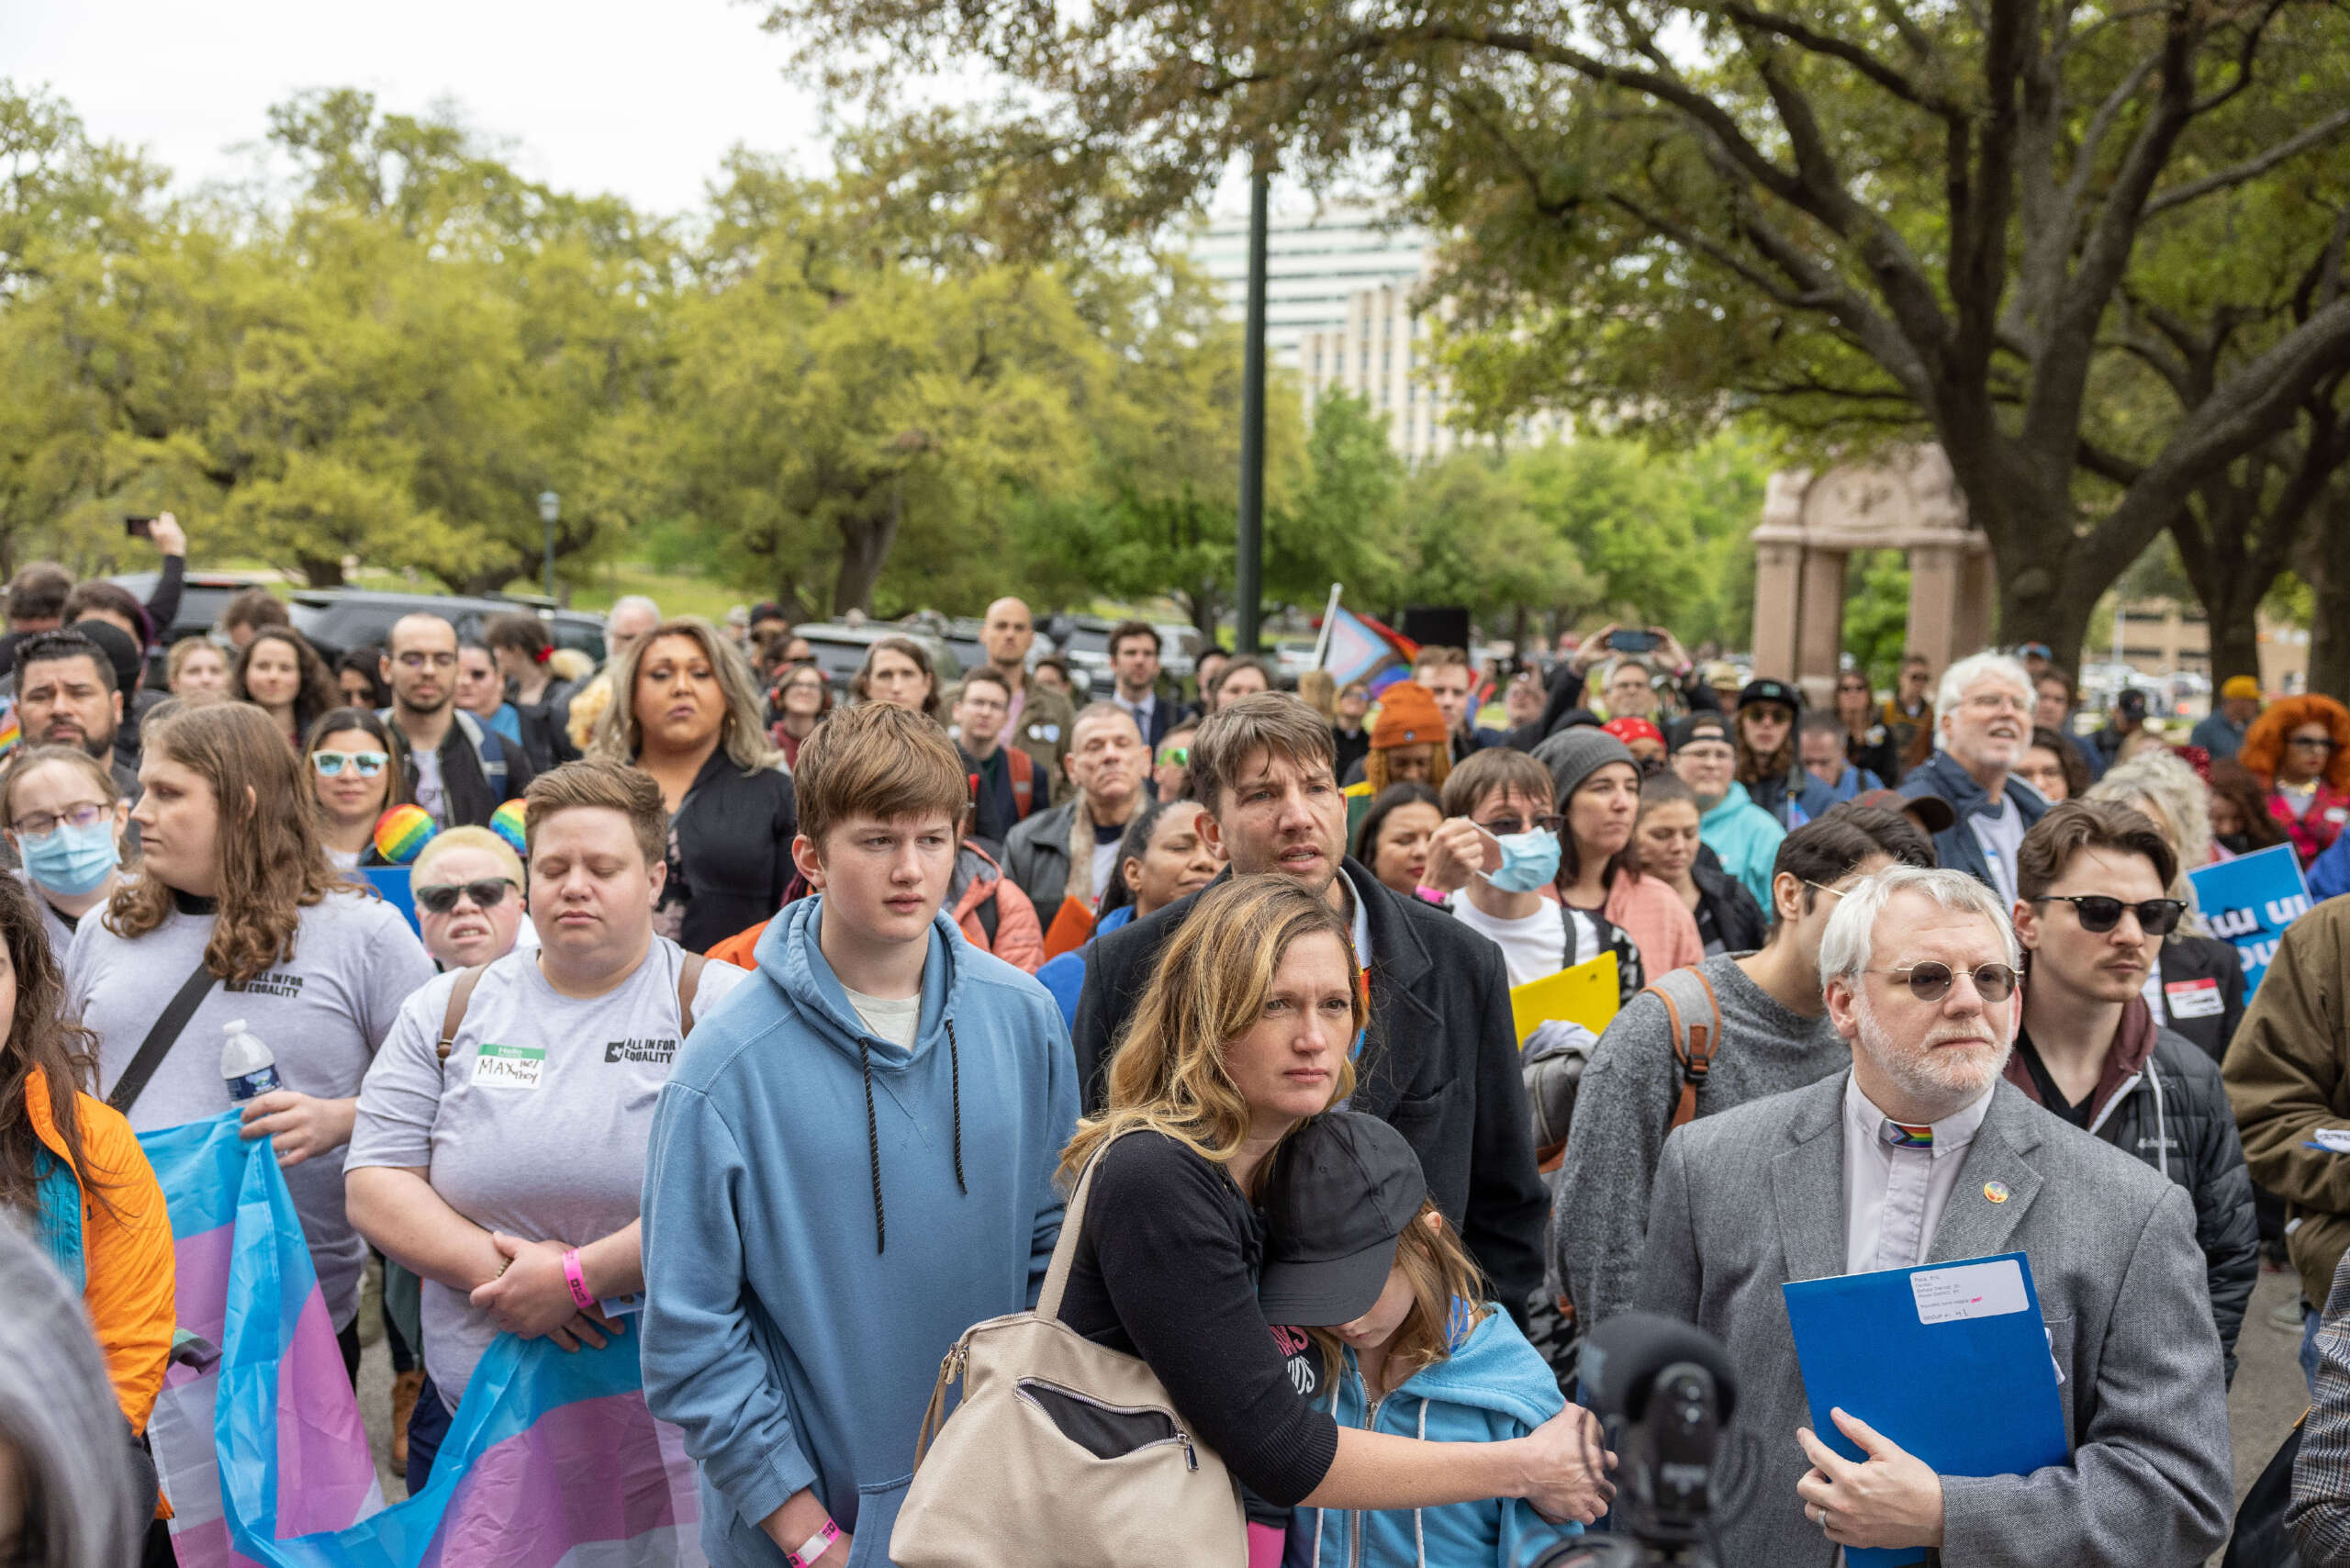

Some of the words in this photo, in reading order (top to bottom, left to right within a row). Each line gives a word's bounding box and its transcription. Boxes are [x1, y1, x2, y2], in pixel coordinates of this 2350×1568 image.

[272, 973, 282, 983] IN
[284, 975, 303, 987] FOR
[249, 983, 299, 998] EQUALITY
[626, 1037, 643, 1050] ALL
[644, 1038, 655, 1049] IN
[656, 1039, 676, 1051] FOR
[624, 1048, 673, 1064] EQUALITY
[478, 1057, 517, 1075] MAX
